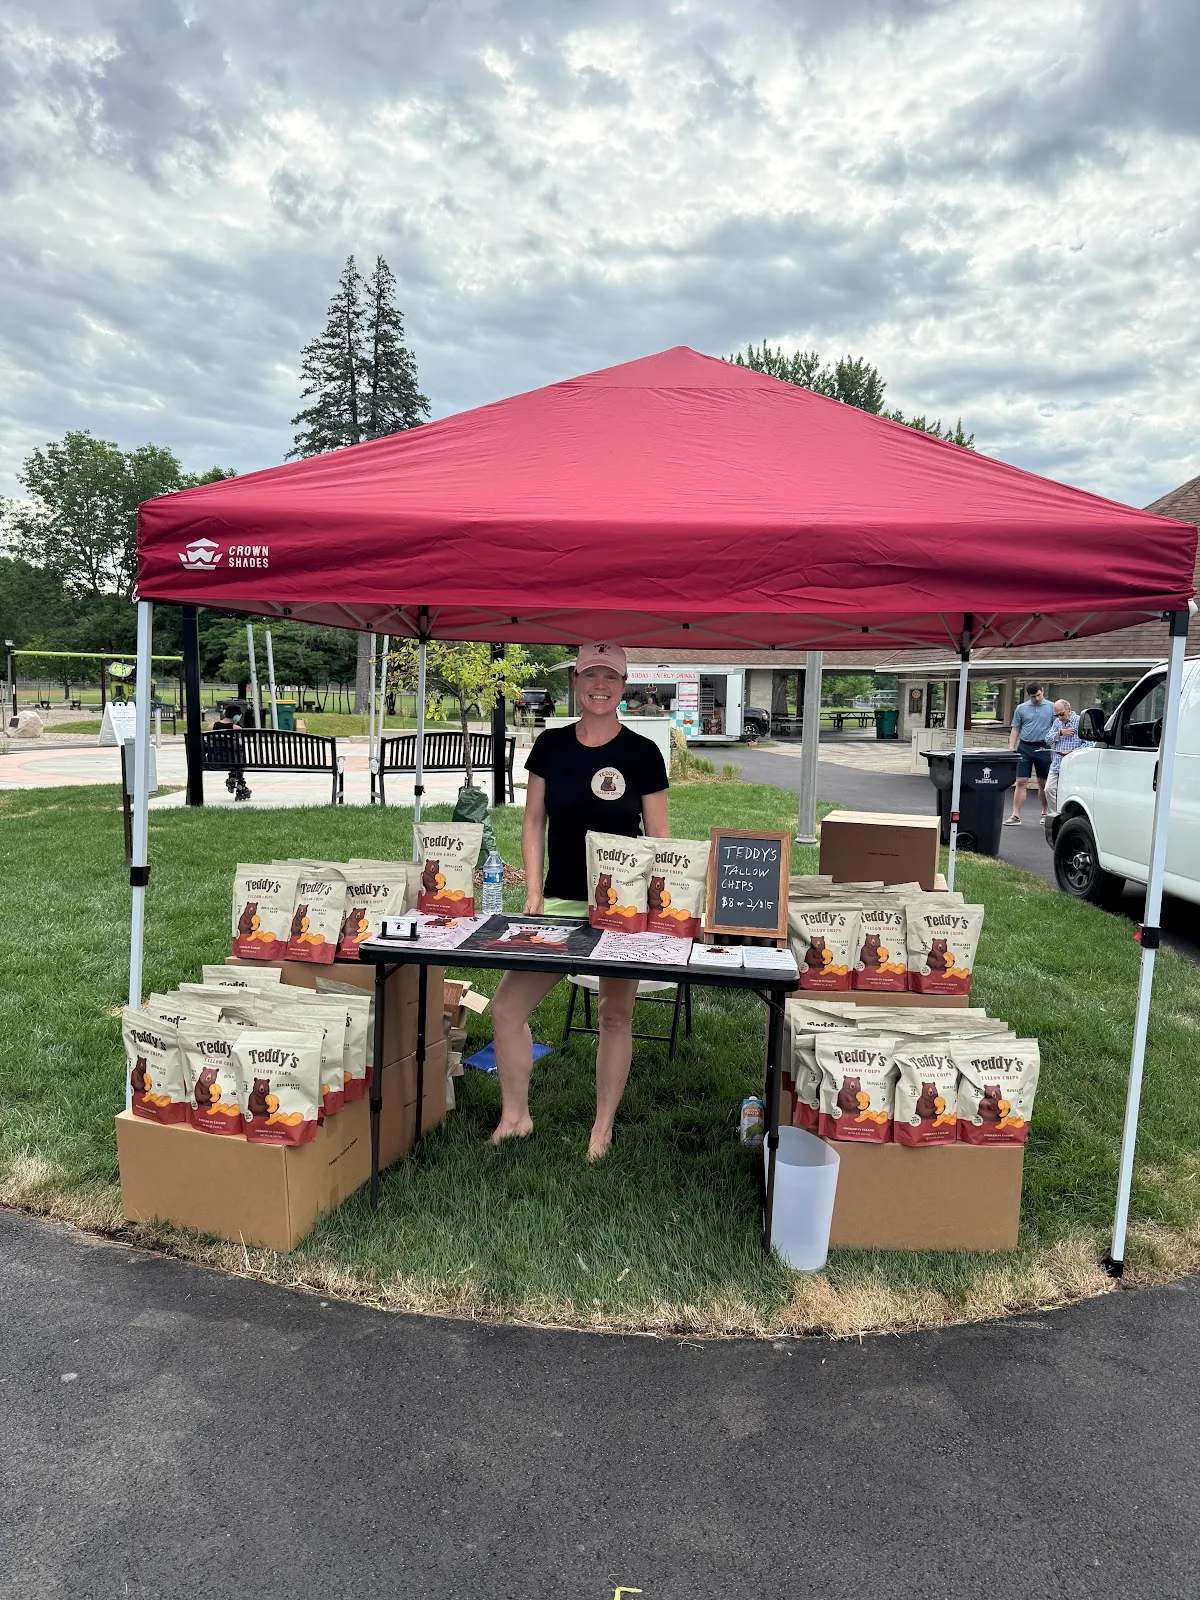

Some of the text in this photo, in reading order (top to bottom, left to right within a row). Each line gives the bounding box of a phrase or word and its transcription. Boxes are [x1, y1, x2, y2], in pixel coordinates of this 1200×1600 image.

[228, 545, 269, 557] CROWN
[228, 557, 269, 569] SHADES
[423, 835, 464, 851] Teddy's
[597, 848, 638, 868] Teddy's
[655, 851, 691, 869] eddy's
[723, 845, 777, 862] TEDDY'S
[723, 864, 770, 877] TALLOW
[245, 878, 281, 893] Teddy's
[300, 882, 332, 896] Teddy's
[346, 883, 390, 898] Teddy's
[721, 878, 754, 891] CHIPS
[721, 896, 734, 908] $8
[800, 911, 846, 926] Teddy's
[923, 914, 969, 929] Teddy's
[130, 1029, 167, 1051] Teddy's
[248, 1048, 300, 1069] Teddy's
[834, 1049, 887, 1067] Teddy's
[908, 1053, 955, 1070] Teddy's
[970, 1056, 1024, 1073] Teddy's
